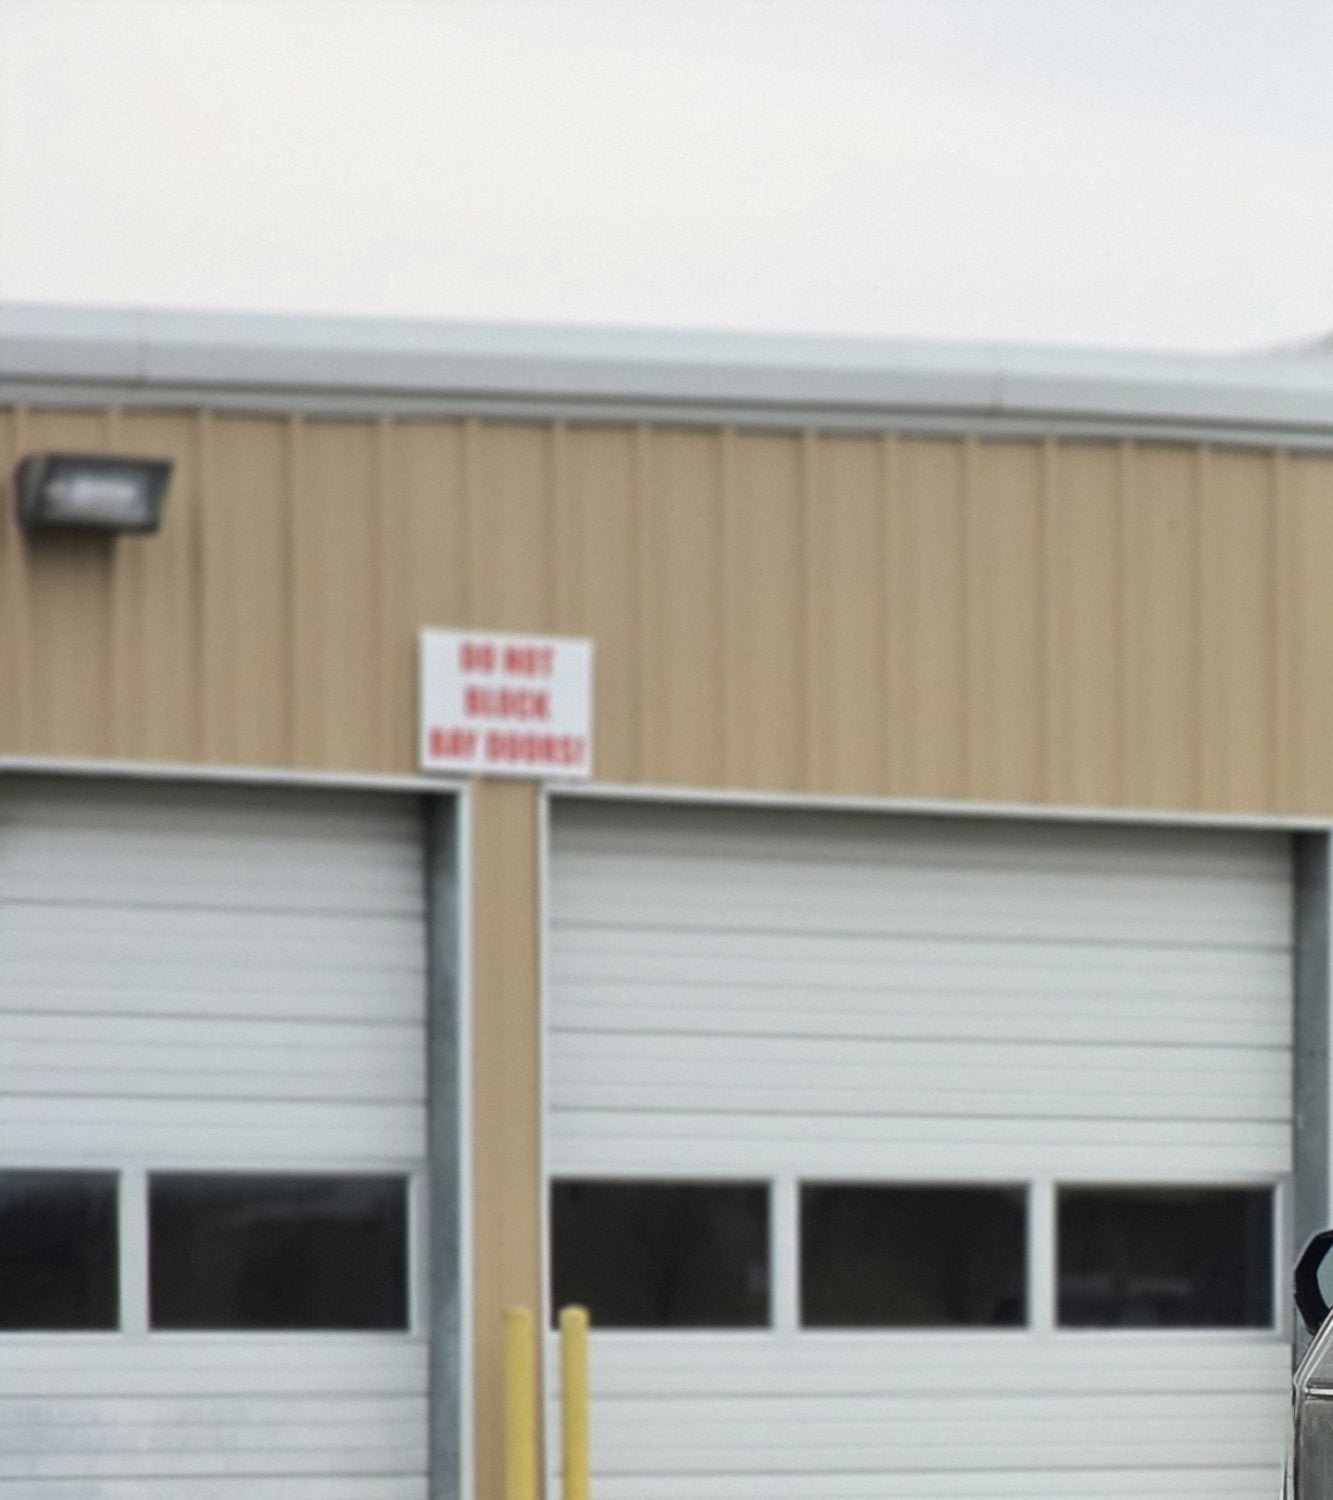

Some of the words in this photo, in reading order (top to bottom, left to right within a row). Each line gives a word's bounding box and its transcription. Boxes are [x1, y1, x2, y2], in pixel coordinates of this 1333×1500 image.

[459, 643, 495, 673] DO
[503, 646, 553, 677] NOT
[463, 685, 549, 720] BLOCK
[429, 726, 477, 759] BAY
